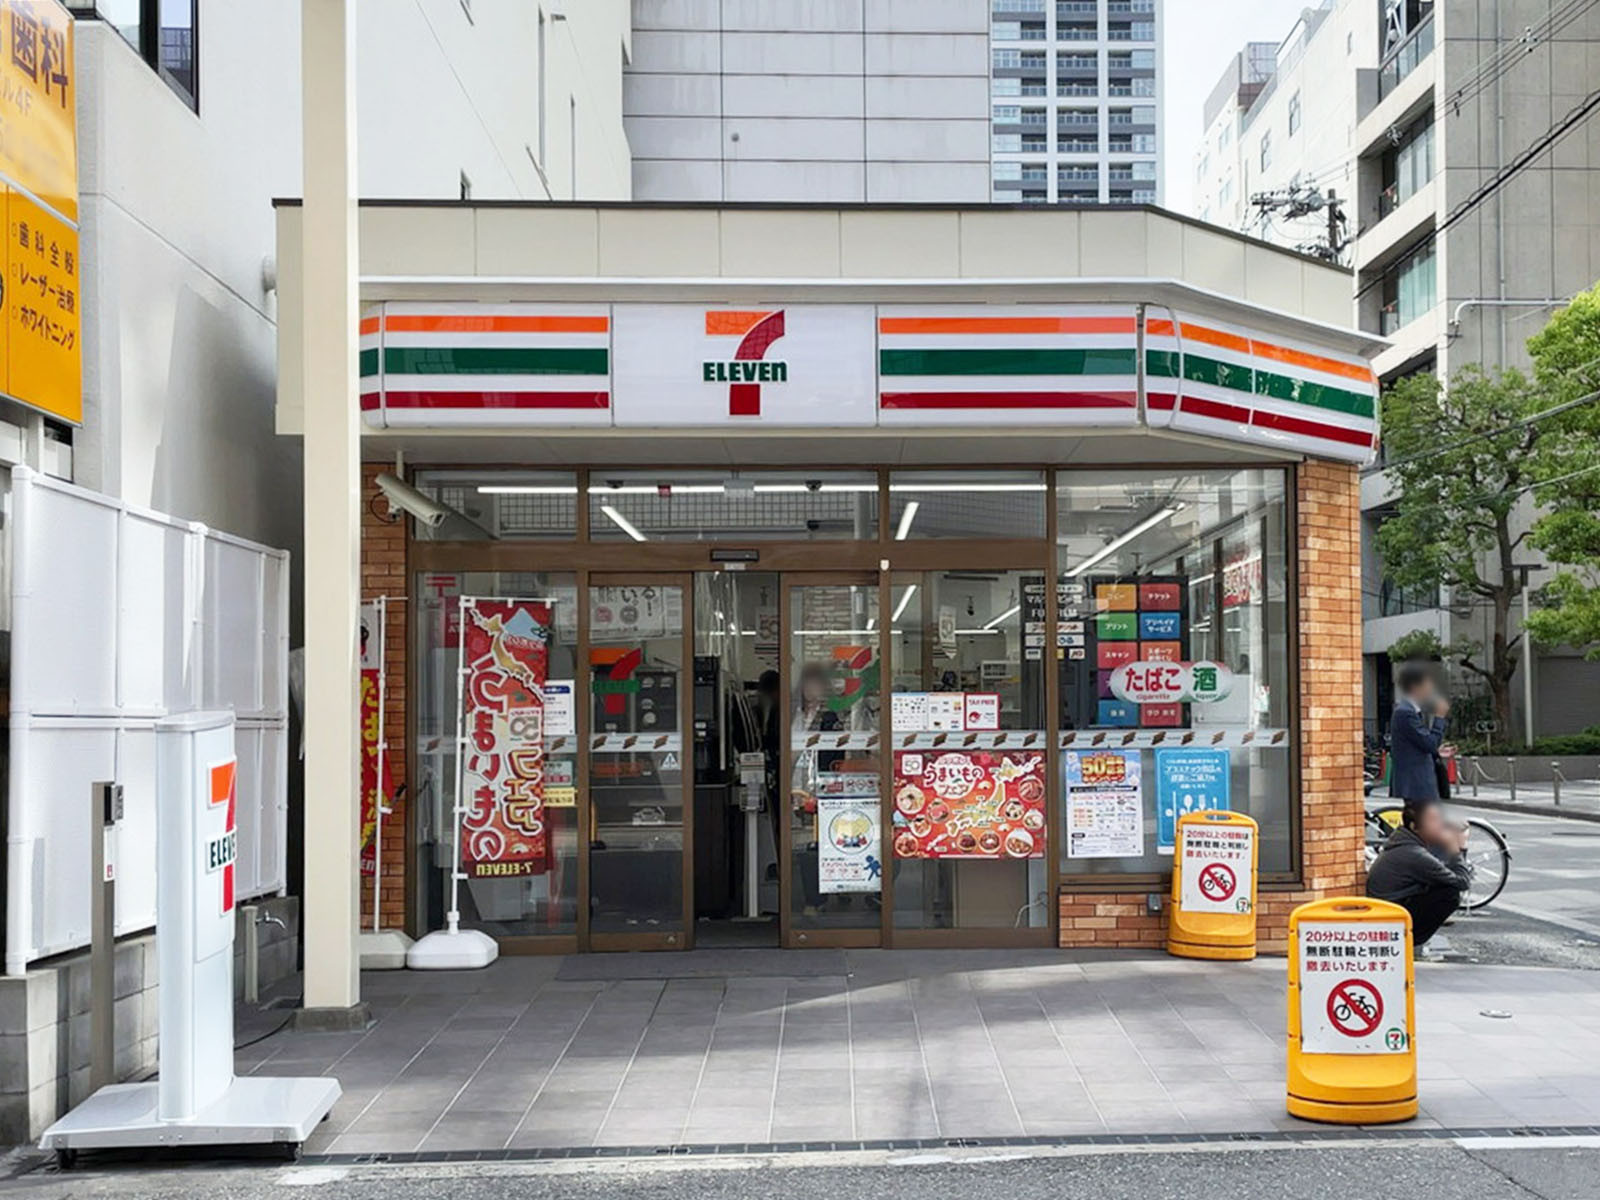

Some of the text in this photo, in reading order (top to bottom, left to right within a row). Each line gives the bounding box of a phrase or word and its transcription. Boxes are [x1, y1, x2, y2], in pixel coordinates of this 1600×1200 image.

[19, 221, 75, 275] 歯科全般
[20, 263, 75, 314] レーザー治療
[20, 304, 75, 350] ホワイトニング
[705, 309, 785, 415] 7
[1105, 623, 1129, 631] プリント
[1148, 648, 1173, 656] スポーツ
[1125, 667, 1182, 692] たばこ
[1193, 667, 1217, 691] 酒
[926, 765, 983, 785] うまいもの
[1187, 830, 1249, 840] 20分以上の駐輪は
[1306, 931, 1399, 942] 20分以上の駐輪は
[1306, 946, 1400, 957] 無断駐輪と判断し
[1306, 961, 1395, 972] 撤去いたします。
